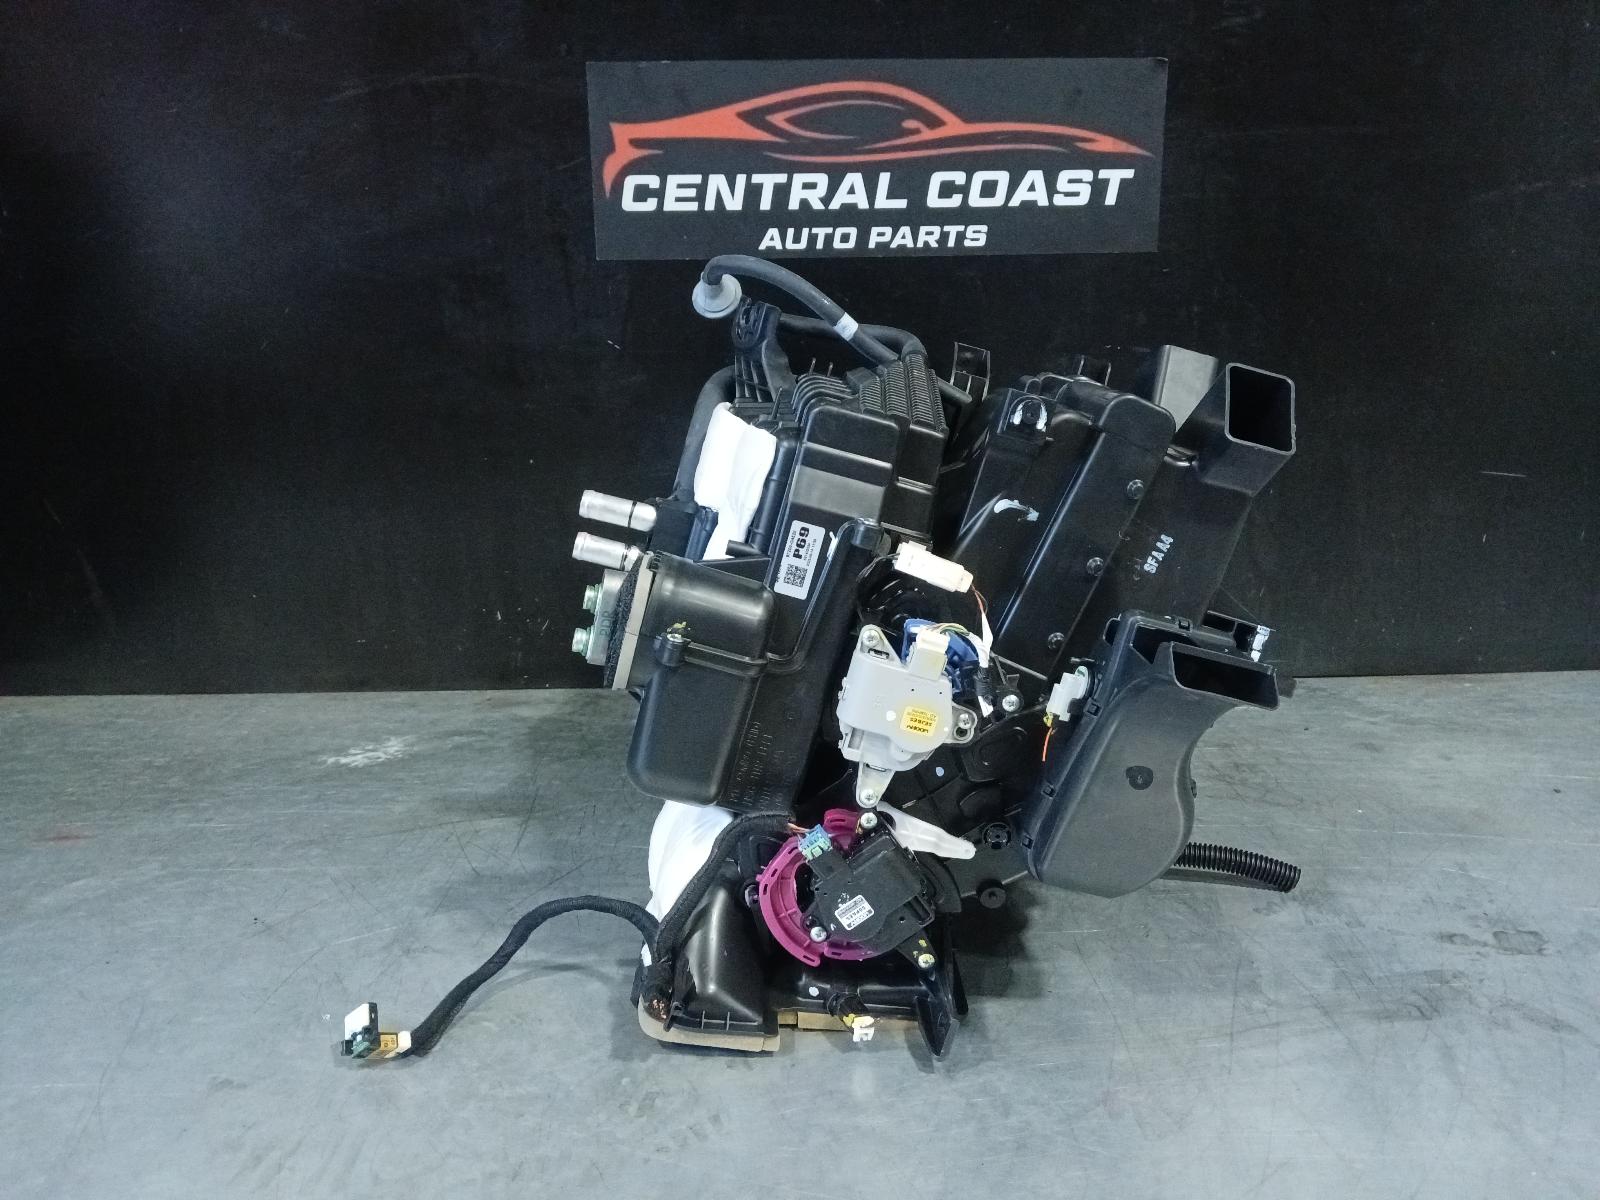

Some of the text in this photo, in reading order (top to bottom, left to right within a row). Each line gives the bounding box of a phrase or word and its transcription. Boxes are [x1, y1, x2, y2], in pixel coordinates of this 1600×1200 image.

[620, 168, 1136, 213] CENTRAL COAST
[758, 224, 989, 251] AUTO PARTS
[792, 526, 810, 560] P69
